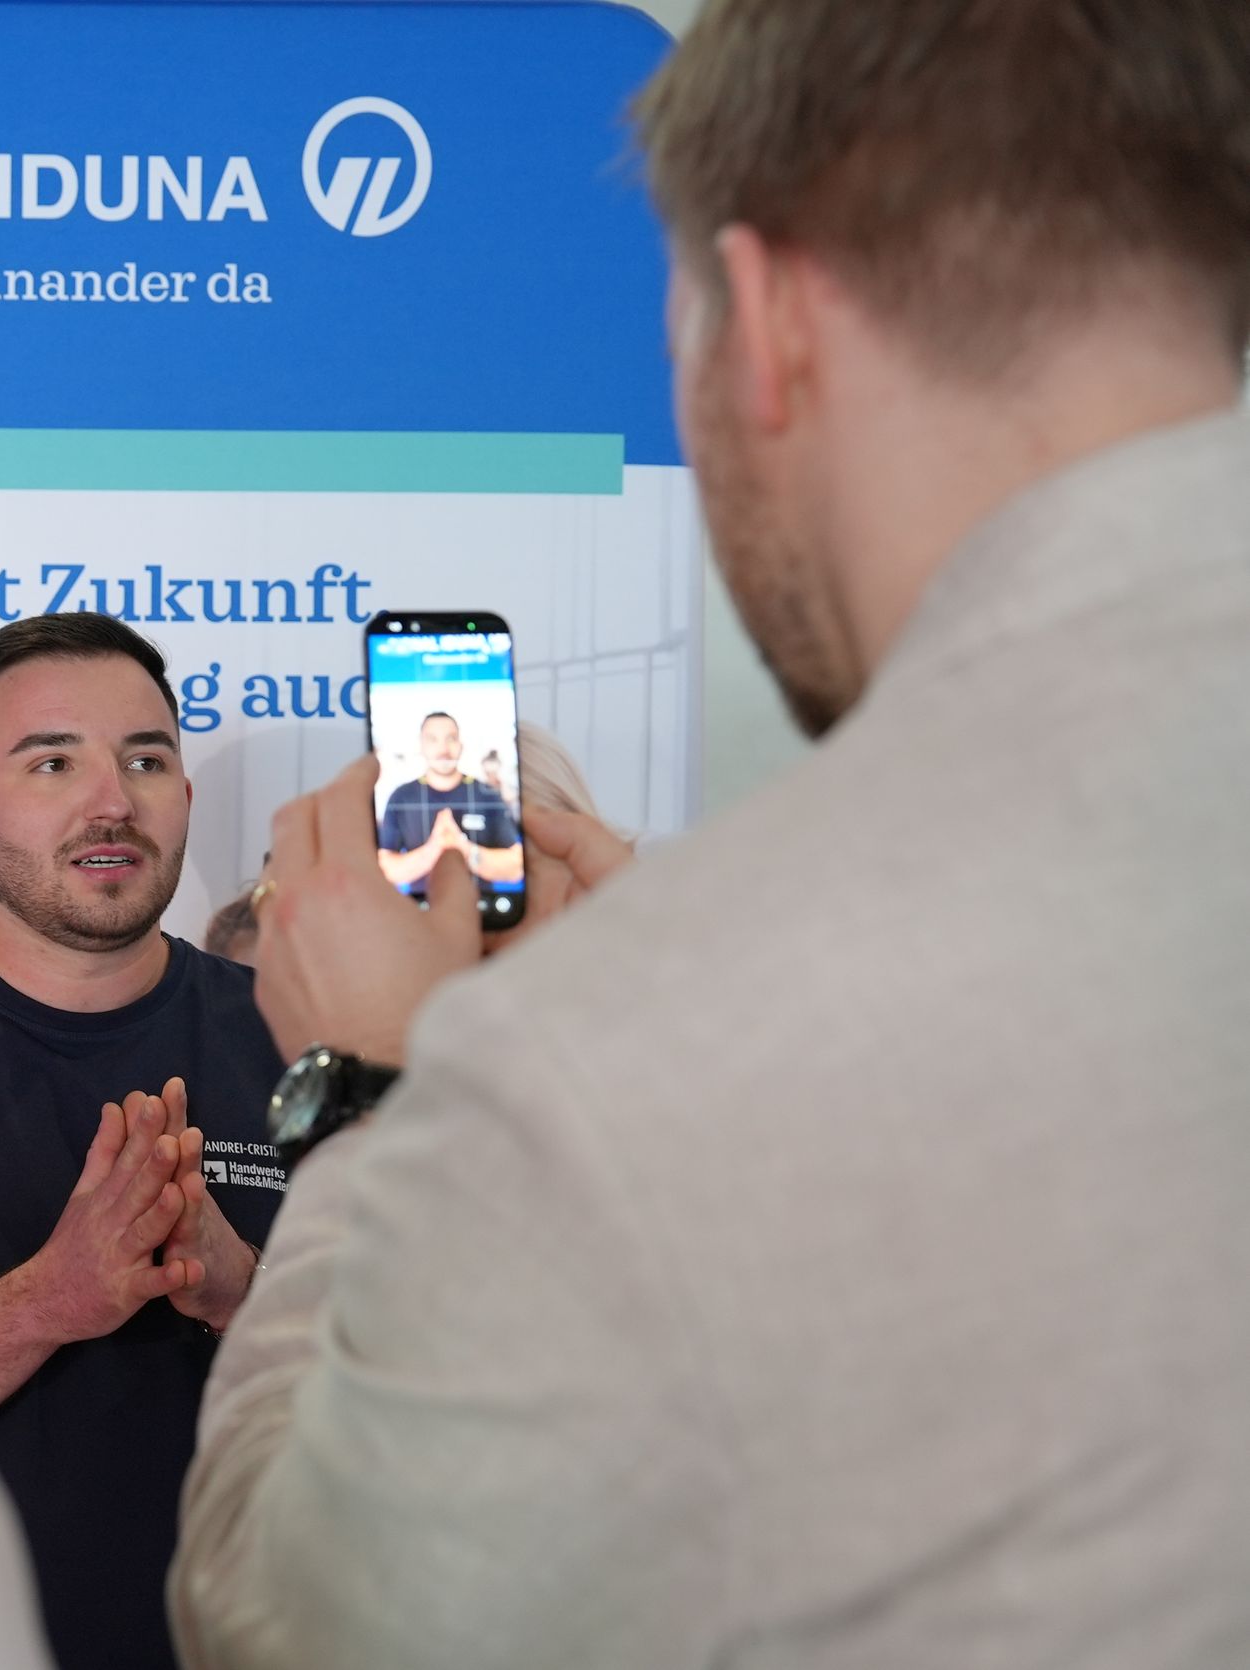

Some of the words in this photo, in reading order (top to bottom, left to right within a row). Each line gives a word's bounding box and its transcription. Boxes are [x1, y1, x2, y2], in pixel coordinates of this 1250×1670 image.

[206, 263, 273, 303] da
[242, 674, 369, 719] auc
[204, 1140, 280, 1158] ANDREI-CRISTI
[229, 1160, 286, 1180] Handwerks
[230, 1172, 290, 1193] Miss&Mister
